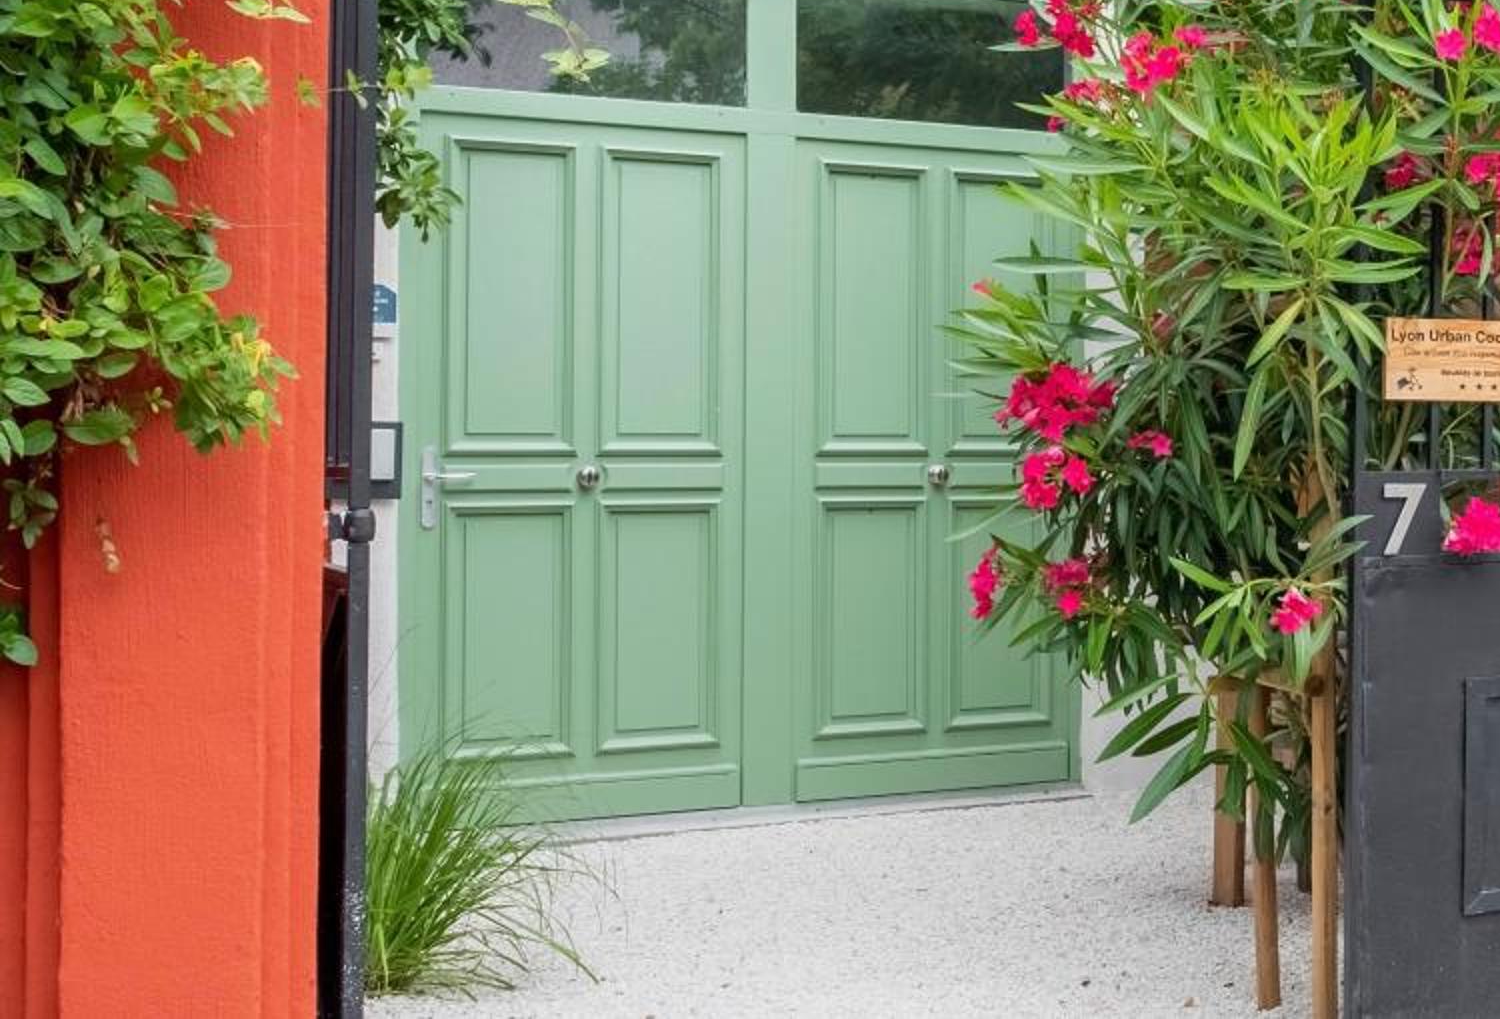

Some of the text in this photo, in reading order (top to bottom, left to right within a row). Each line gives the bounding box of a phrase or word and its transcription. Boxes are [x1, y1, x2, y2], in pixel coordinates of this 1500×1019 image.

[1391, 328, 1425, 344] Lyon
[1429, 329, 1471, 343] Urban
[1383, 483, 1428, 557] 7
